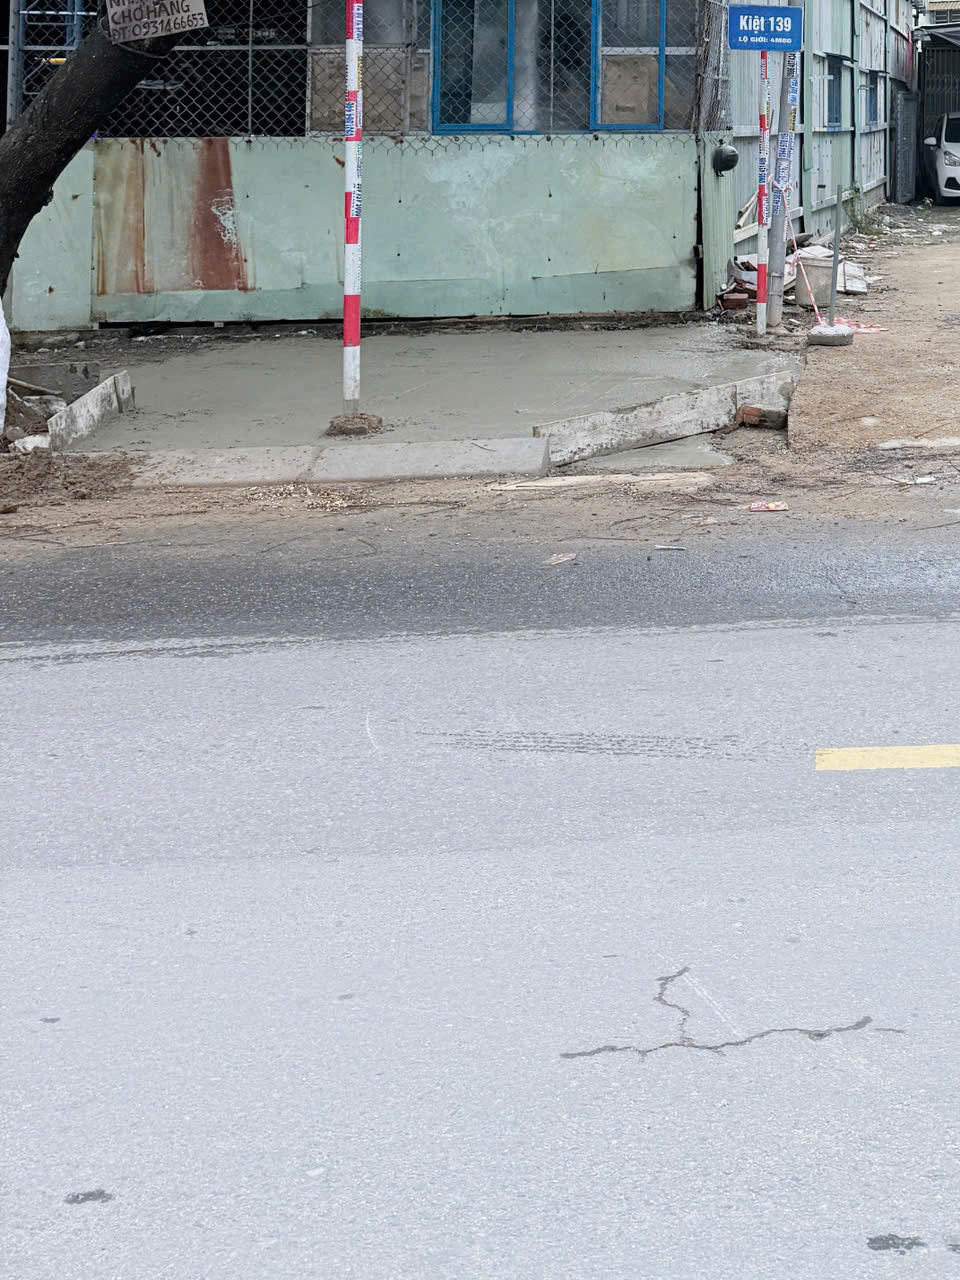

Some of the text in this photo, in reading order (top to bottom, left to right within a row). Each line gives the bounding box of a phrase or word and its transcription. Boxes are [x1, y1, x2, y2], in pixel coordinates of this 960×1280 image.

[739, 14, 792, 34] Kiệt 139
[738, 35, 748, 43] LỘ
